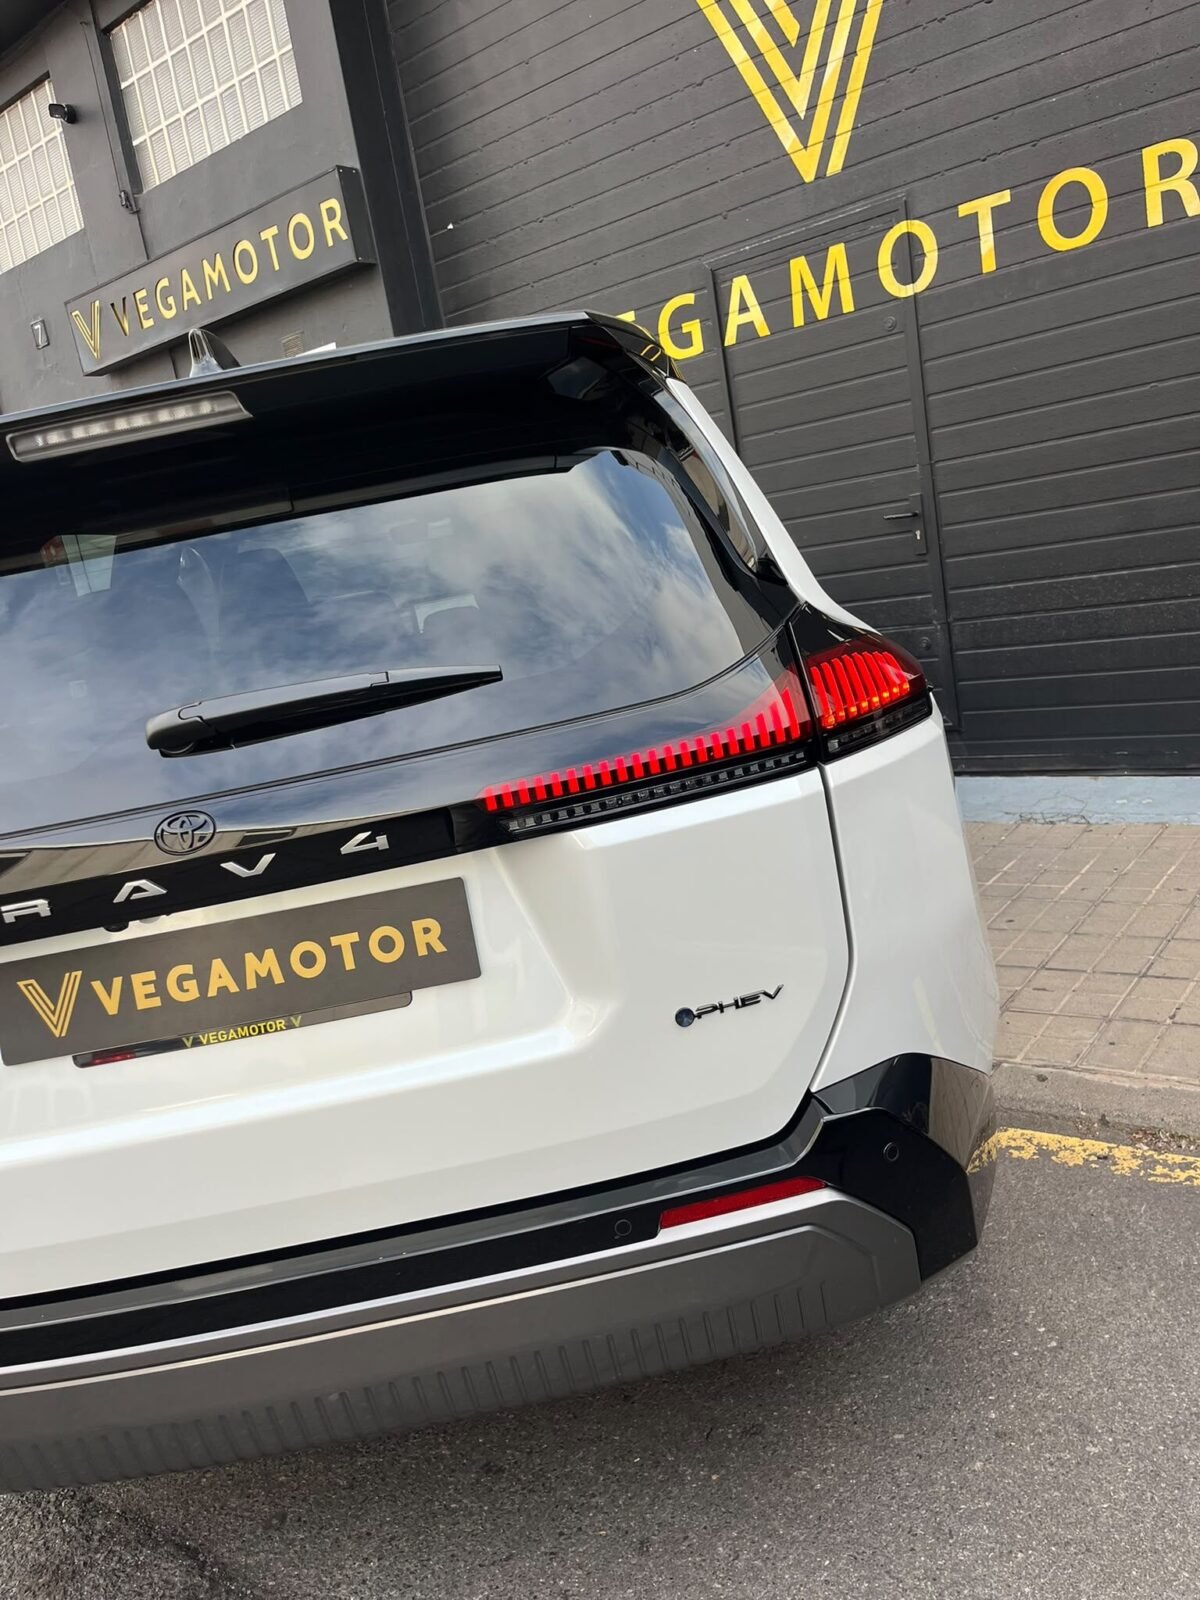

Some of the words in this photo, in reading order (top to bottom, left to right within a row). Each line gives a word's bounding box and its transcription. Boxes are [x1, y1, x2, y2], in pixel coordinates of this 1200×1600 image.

[110, 197, 349, 337] VEGAMOTOR
[616, 138, 1200, 360] GAMOTOR
[90, 917, 448, 1016] VEGAMOTOR
[695, 983, 784, 1019] PHEV
[199, 1019, 287, 1046] VEGAMOTOR
